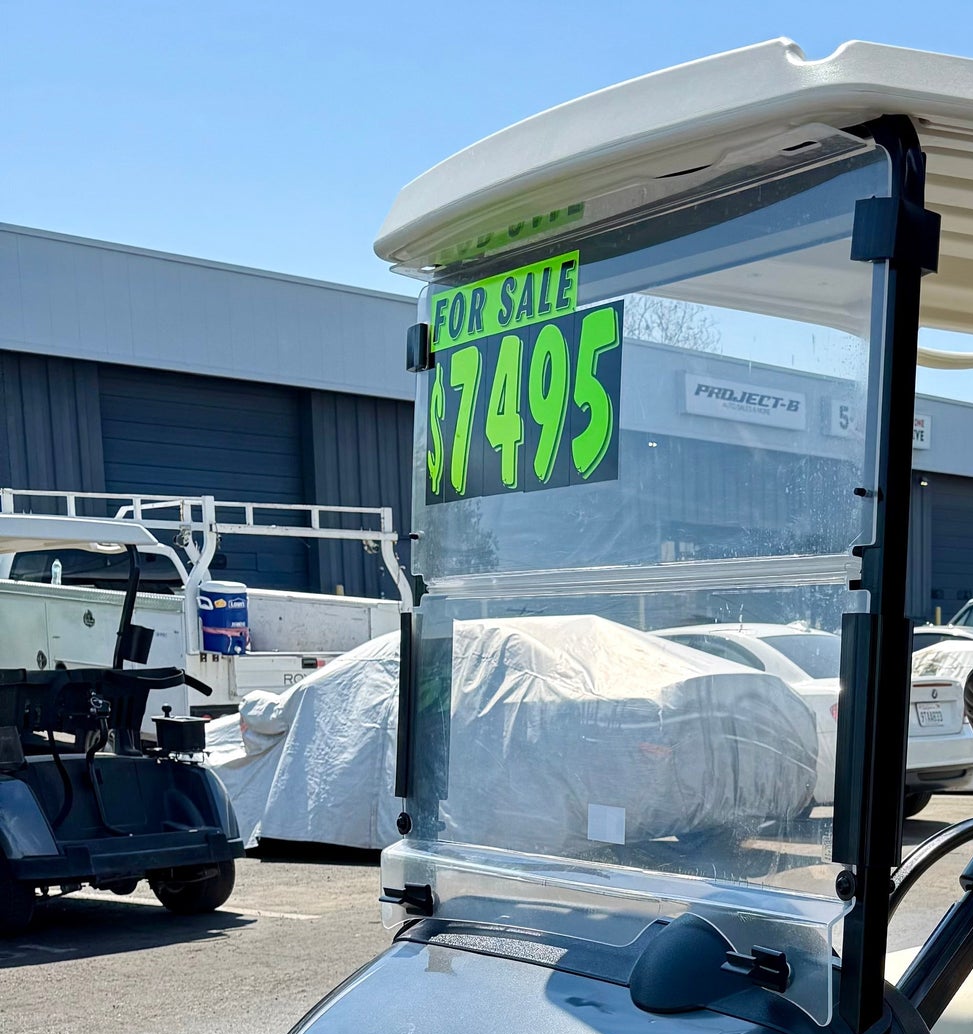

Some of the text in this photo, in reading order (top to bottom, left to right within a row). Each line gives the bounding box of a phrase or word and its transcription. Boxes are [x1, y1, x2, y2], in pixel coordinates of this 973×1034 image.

[433, 259, 577, 345] FOR SALE
[427, 307, 620, 497] $7495
[694, 383, 800, 412] PROJECT-B
[283, 673, 307, 685] RO
